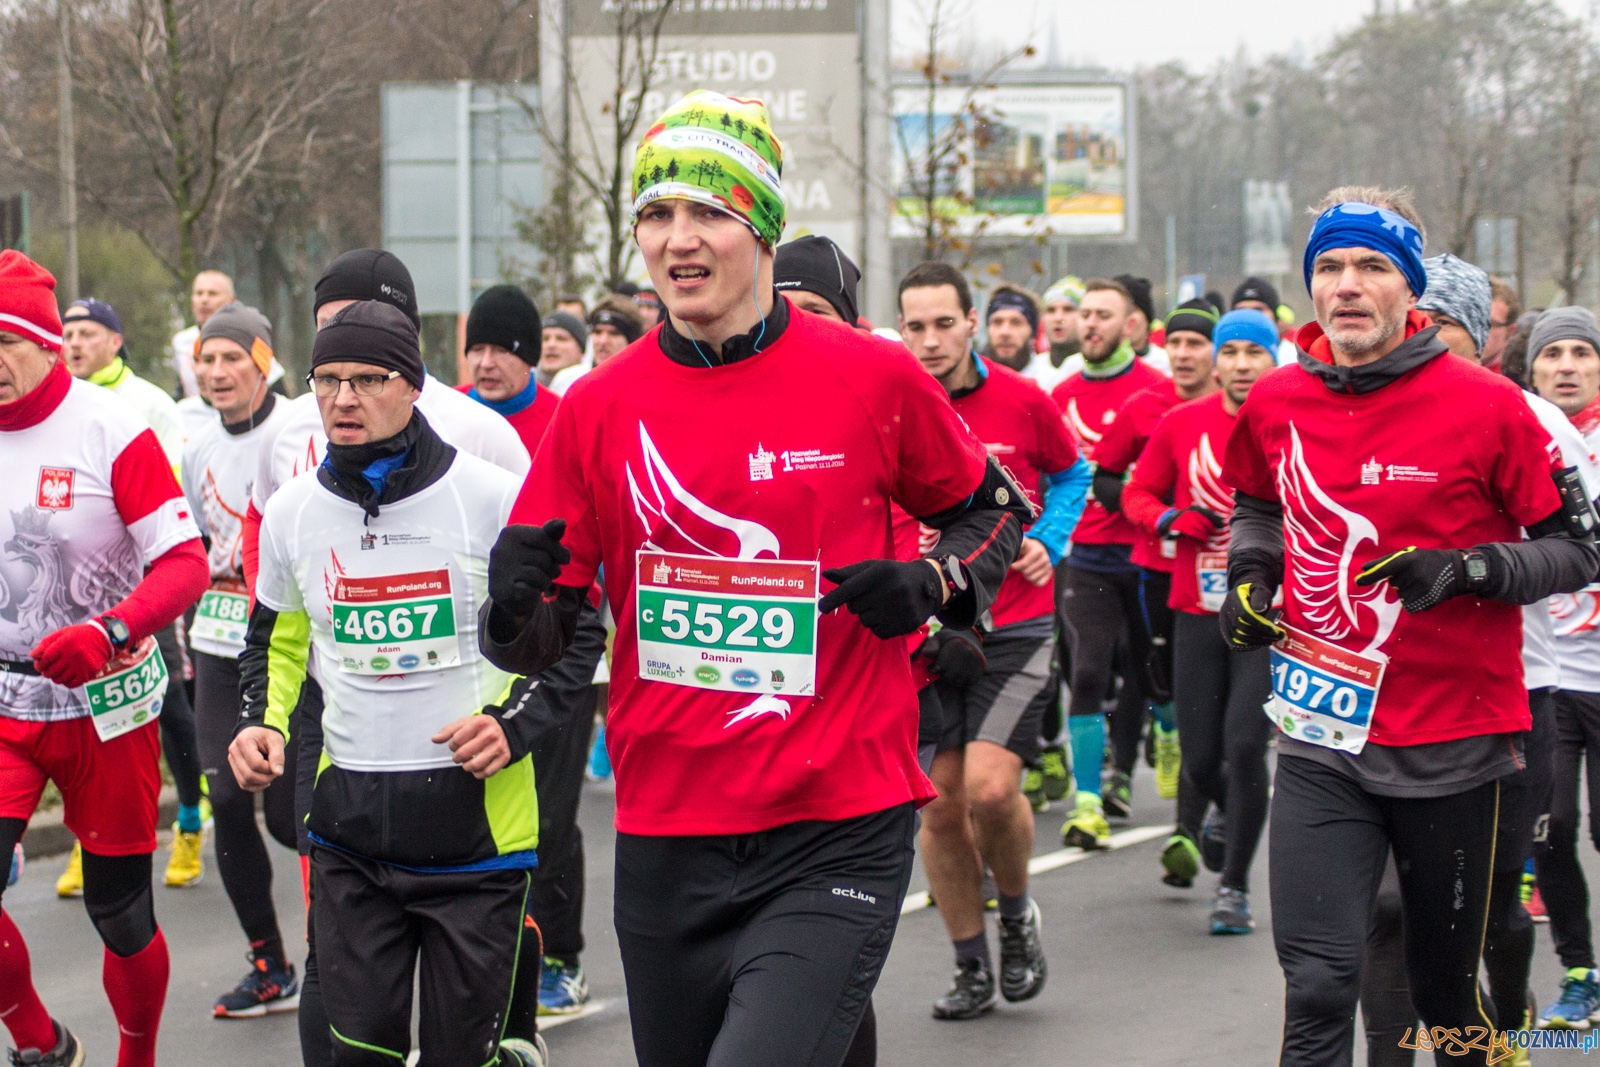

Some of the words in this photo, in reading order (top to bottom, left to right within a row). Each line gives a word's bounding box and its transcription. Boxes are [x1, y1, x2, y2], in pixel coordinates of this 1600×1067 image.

[651, 51, 776, 82] STUDIO
[44, 470, 71, 479] POLSKA
[386, 581, 442, 594] RunPoland.org
[731, 575, 804, 590] RunPoland.org
[344, 604, 439, 641] 4667
[660, 599, 795, 649] 5529
[647, 660, 671, 671] GRUPA
[701, 652, 743, 664] Damian
[103, 655, 161, 707] 5624
[647, 668, 676, 679] LUXMED
[1275, 662, 1359, 718] 1970
[831, 887, 876, 904] active
